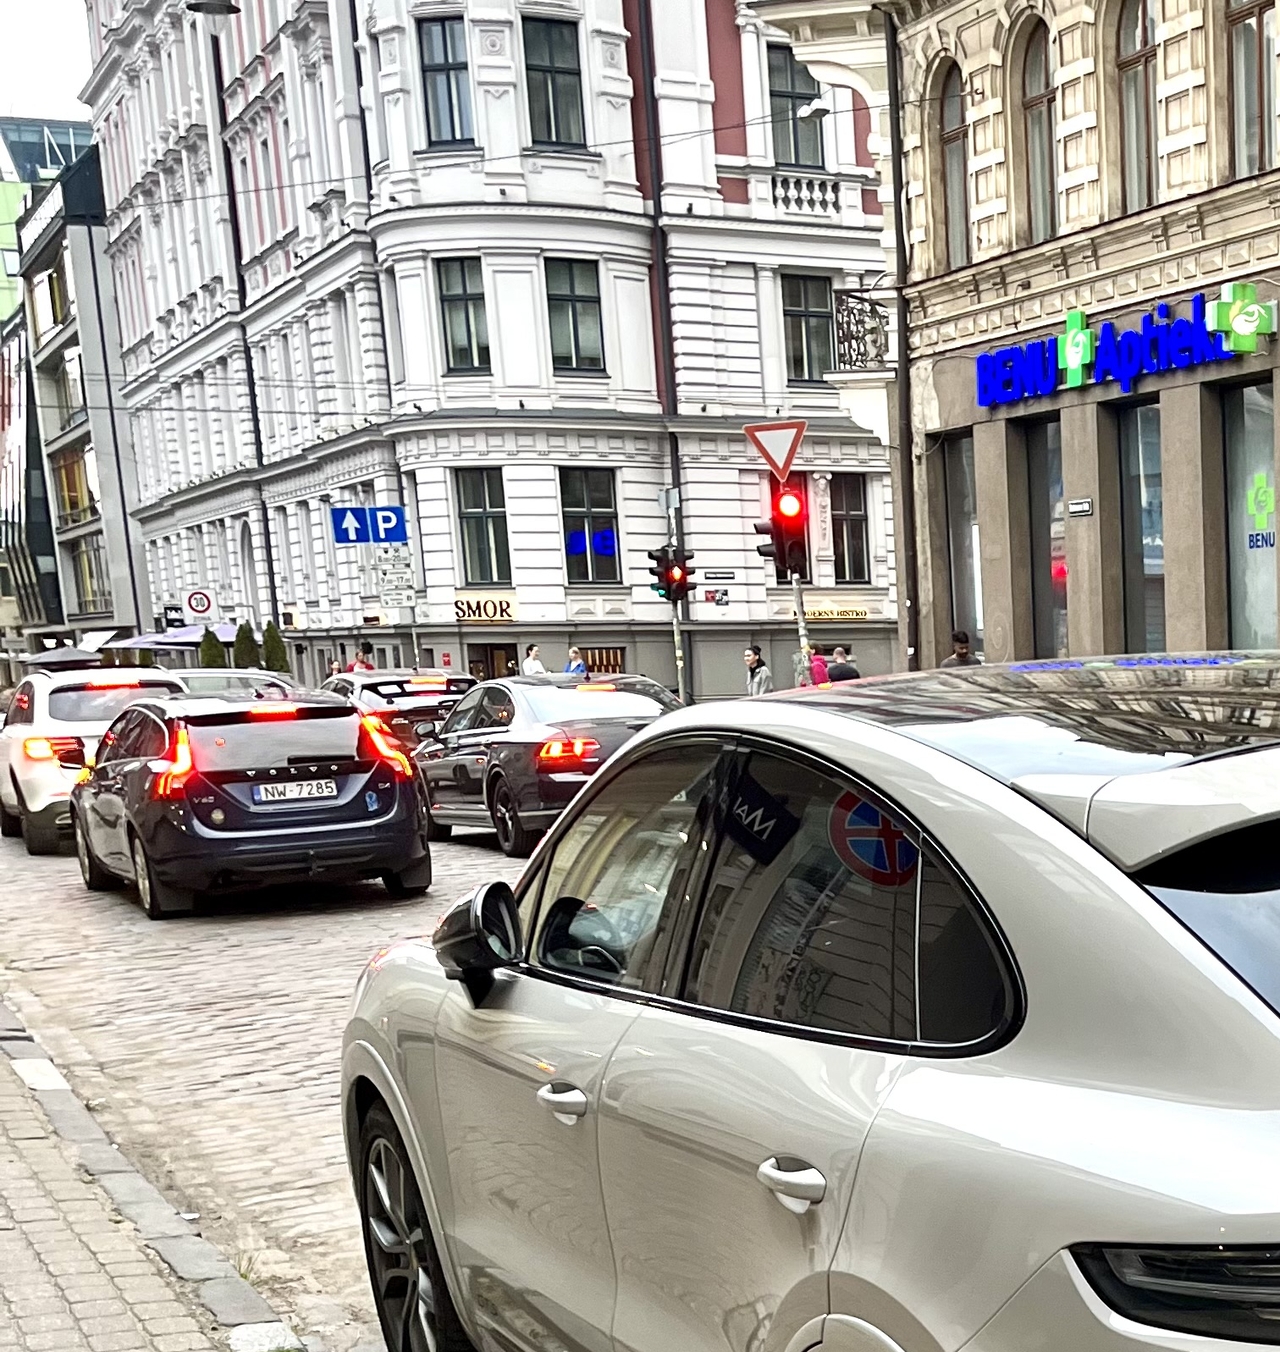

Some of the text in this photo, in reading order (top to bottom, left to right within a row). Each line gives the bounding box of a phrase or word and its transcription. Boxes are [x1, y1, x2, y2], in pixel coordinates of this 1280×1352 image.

[976, 336, 1057, 408] BENU
[376, 510, 398, 539] P
[1248, 531, 1276, 549] BENU
[194, 597, 206, 608] 30
[454, 600, 512, 619] SMOR
[263, 780, 335, 800] NW-7285
